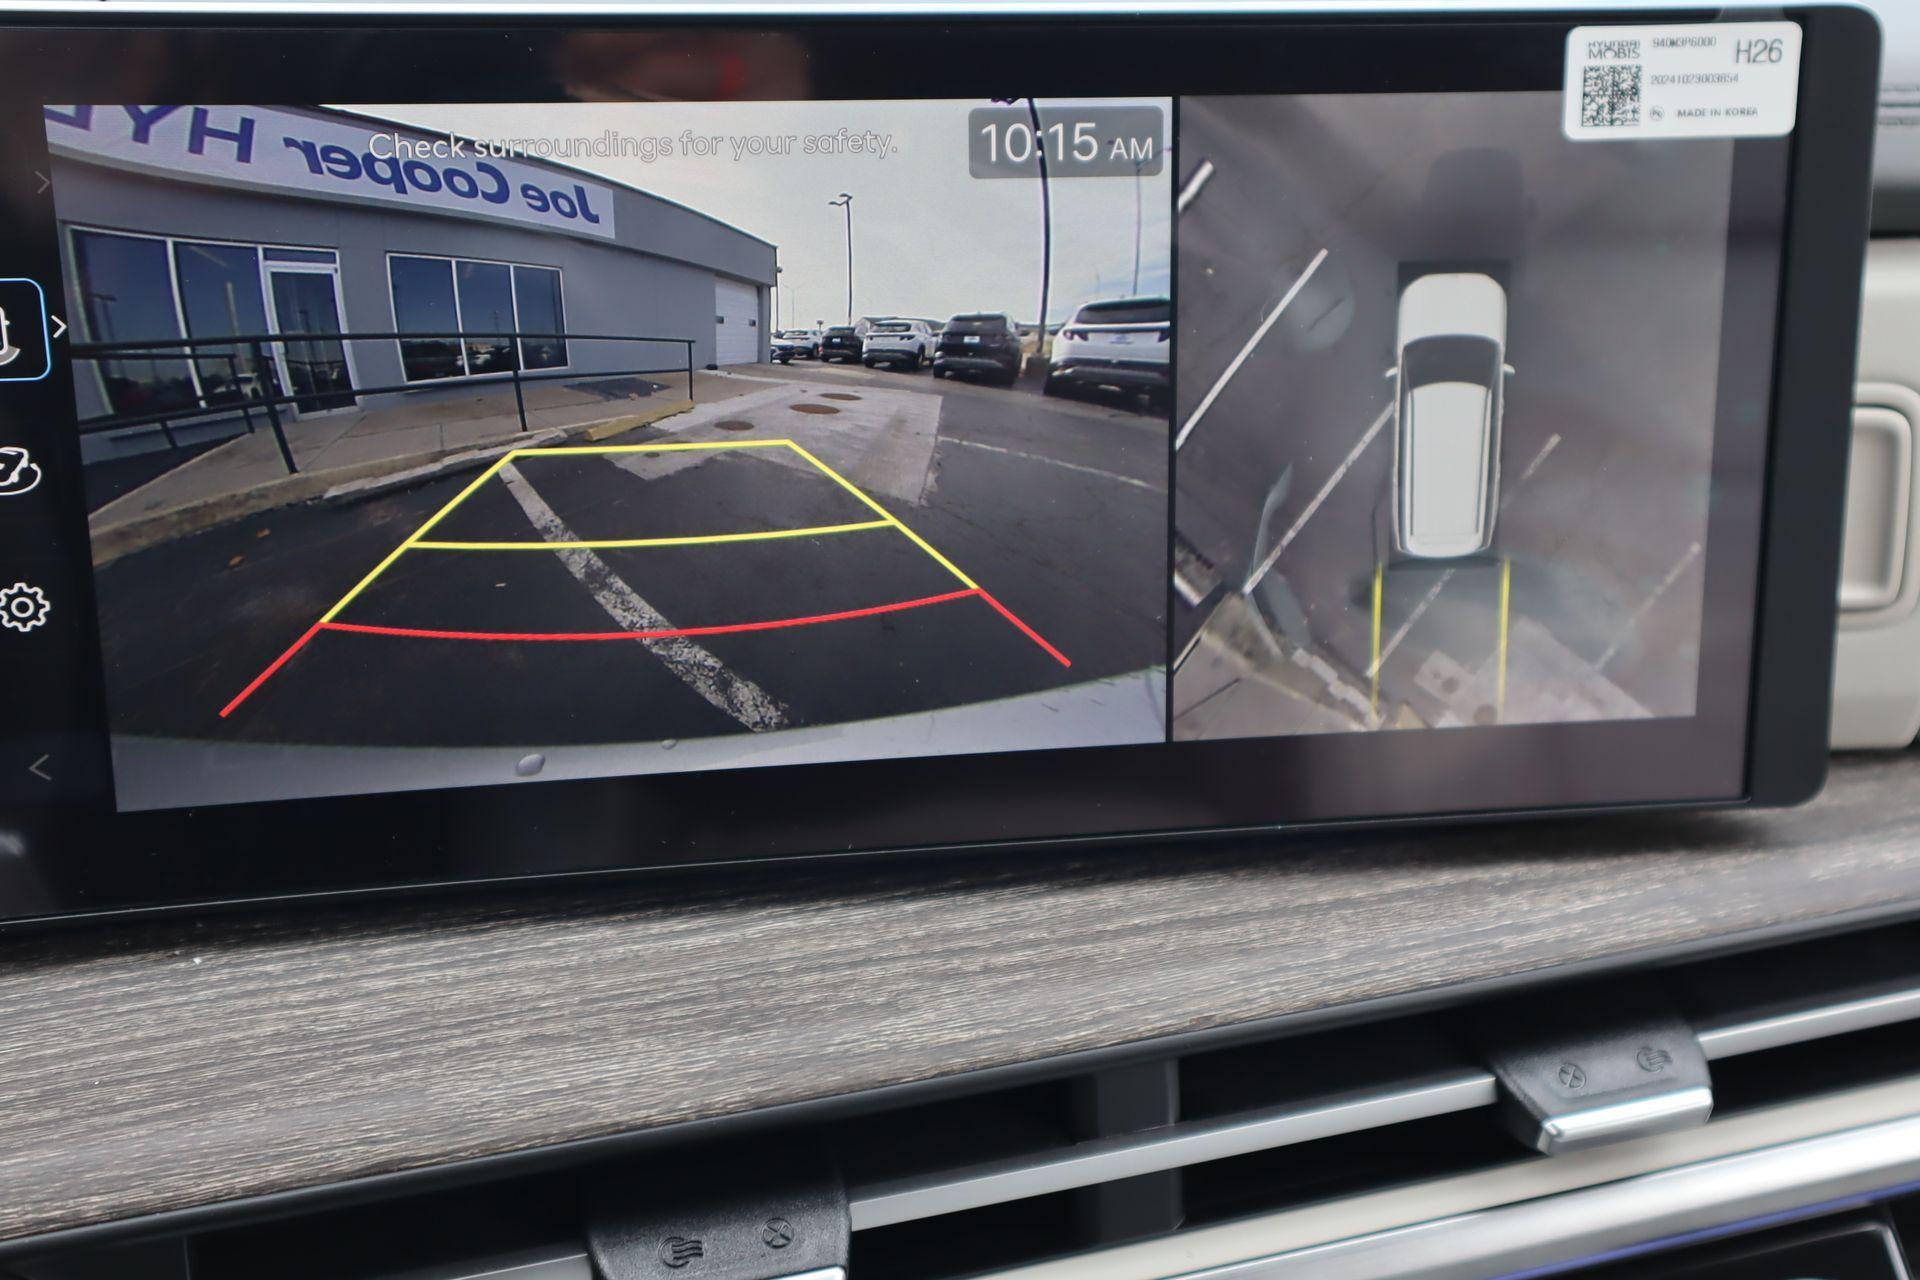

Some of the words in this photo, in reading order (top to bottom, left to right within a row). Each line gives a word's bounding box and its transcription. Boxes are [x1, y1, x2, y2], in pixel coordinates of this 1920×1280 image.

[1588, 47, 1640, 59] MOBIS
[1735, 38, 1783, 64] H26
[1677, 108, 1706, 118] MADE
[1710, 107, 1721, 117] IN
[1725, 106, 1758, 117] KOREA
[368, 131, 467, 159] Check
[473, 128, 673, 163] surroundings
[679, 129, 724, 156] for
[730, 134, 797, 161] your
[802, 127, 898, 160] safety.
[981, 122, 1099, 162] 10:15
[1110, 136, 1153, 160] AM
